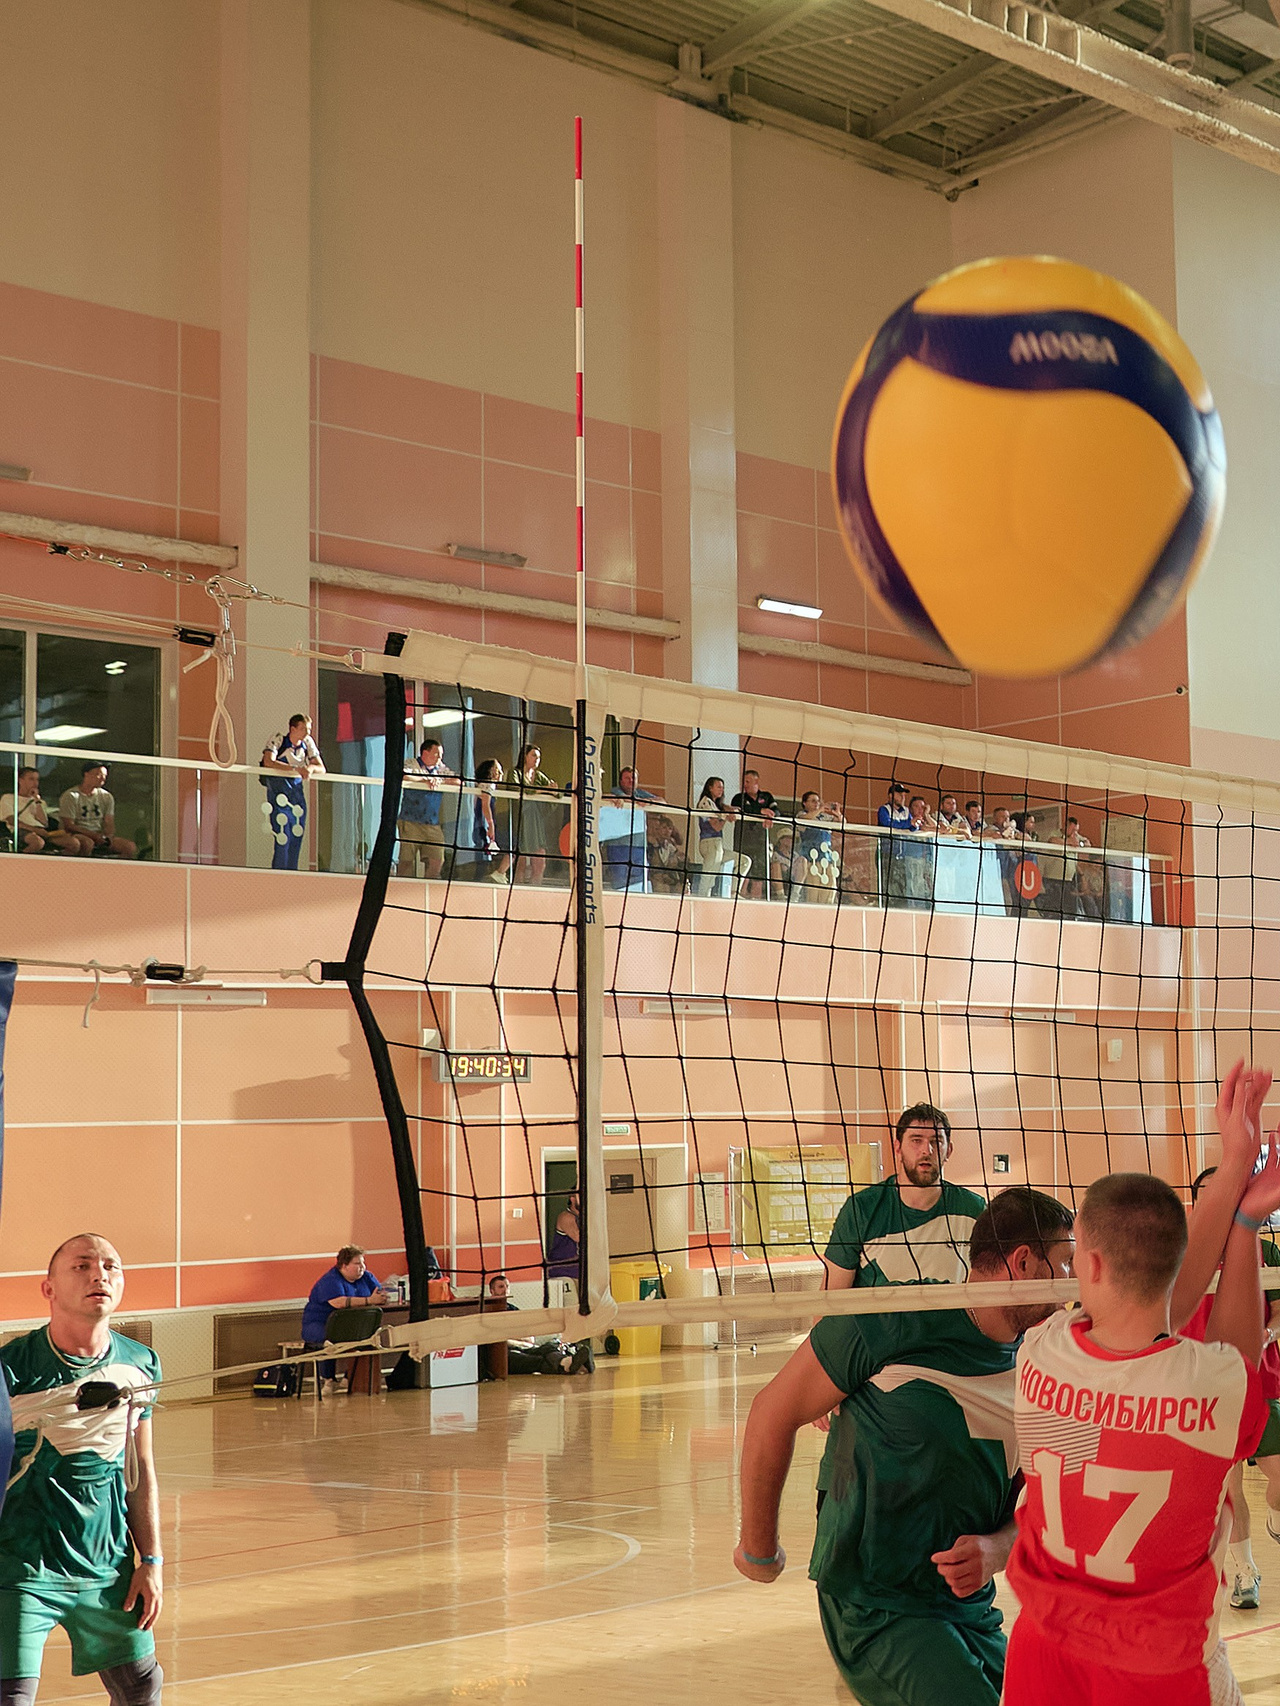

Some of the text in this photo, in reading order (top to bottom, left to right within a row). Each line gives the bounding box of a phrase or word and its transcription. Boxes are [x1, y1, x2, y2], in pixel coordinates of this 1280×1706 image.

[451, 1056, 525, 1077] 19:40:34
[1020, 1358, 1219, 1433] НОВОСИБИРСК
[1032, 1448, 1174, 1583] 17
